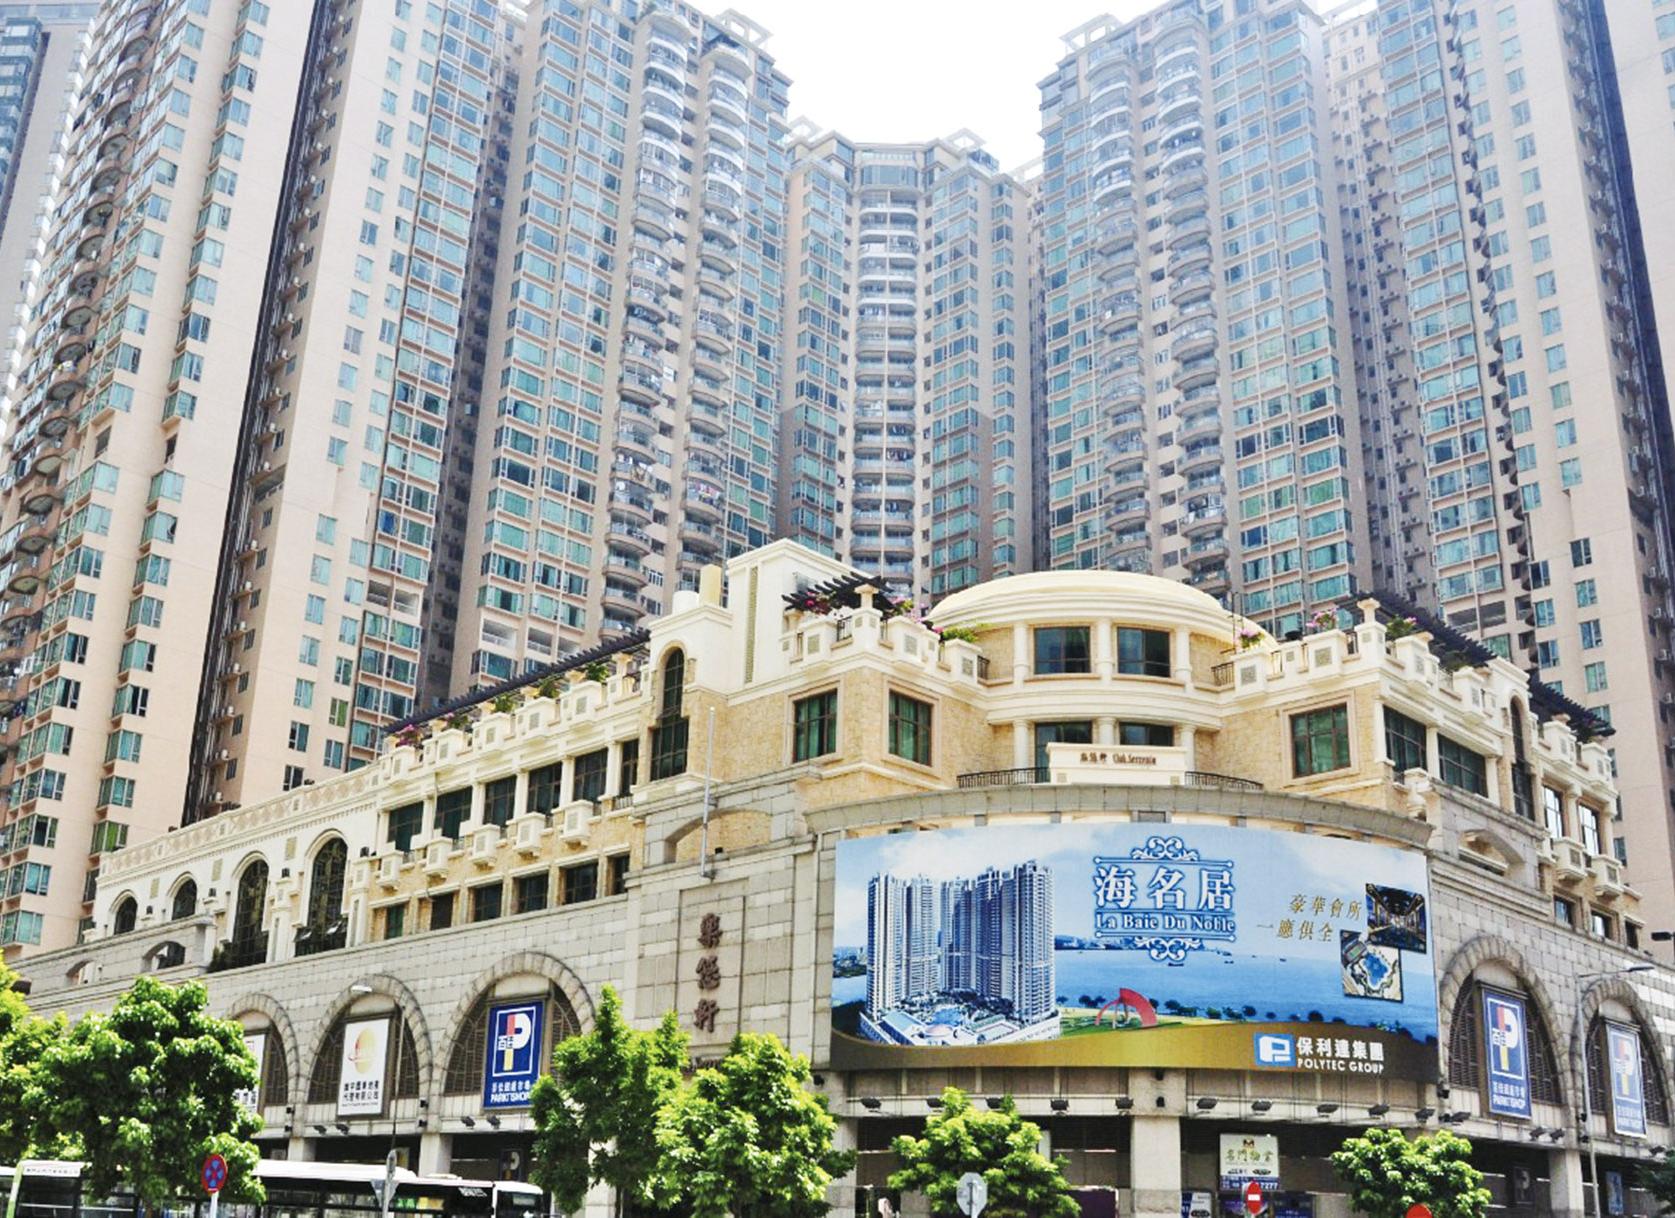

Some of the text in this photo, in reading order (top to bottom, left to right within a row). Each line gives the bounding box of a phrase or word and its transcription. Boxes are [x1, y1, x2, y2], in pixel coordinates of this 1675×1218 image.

[1094, 866, 1235, 909] 海名居
[1290, 893, 1362, 920] 豪華會所
[1096, 914, 1236, 932] La Baie Du Noble
[1297, 1036, 1384, 1061] 保利達集團
[1298, 1059, 1384, 1074] POLYTEC GROUP
